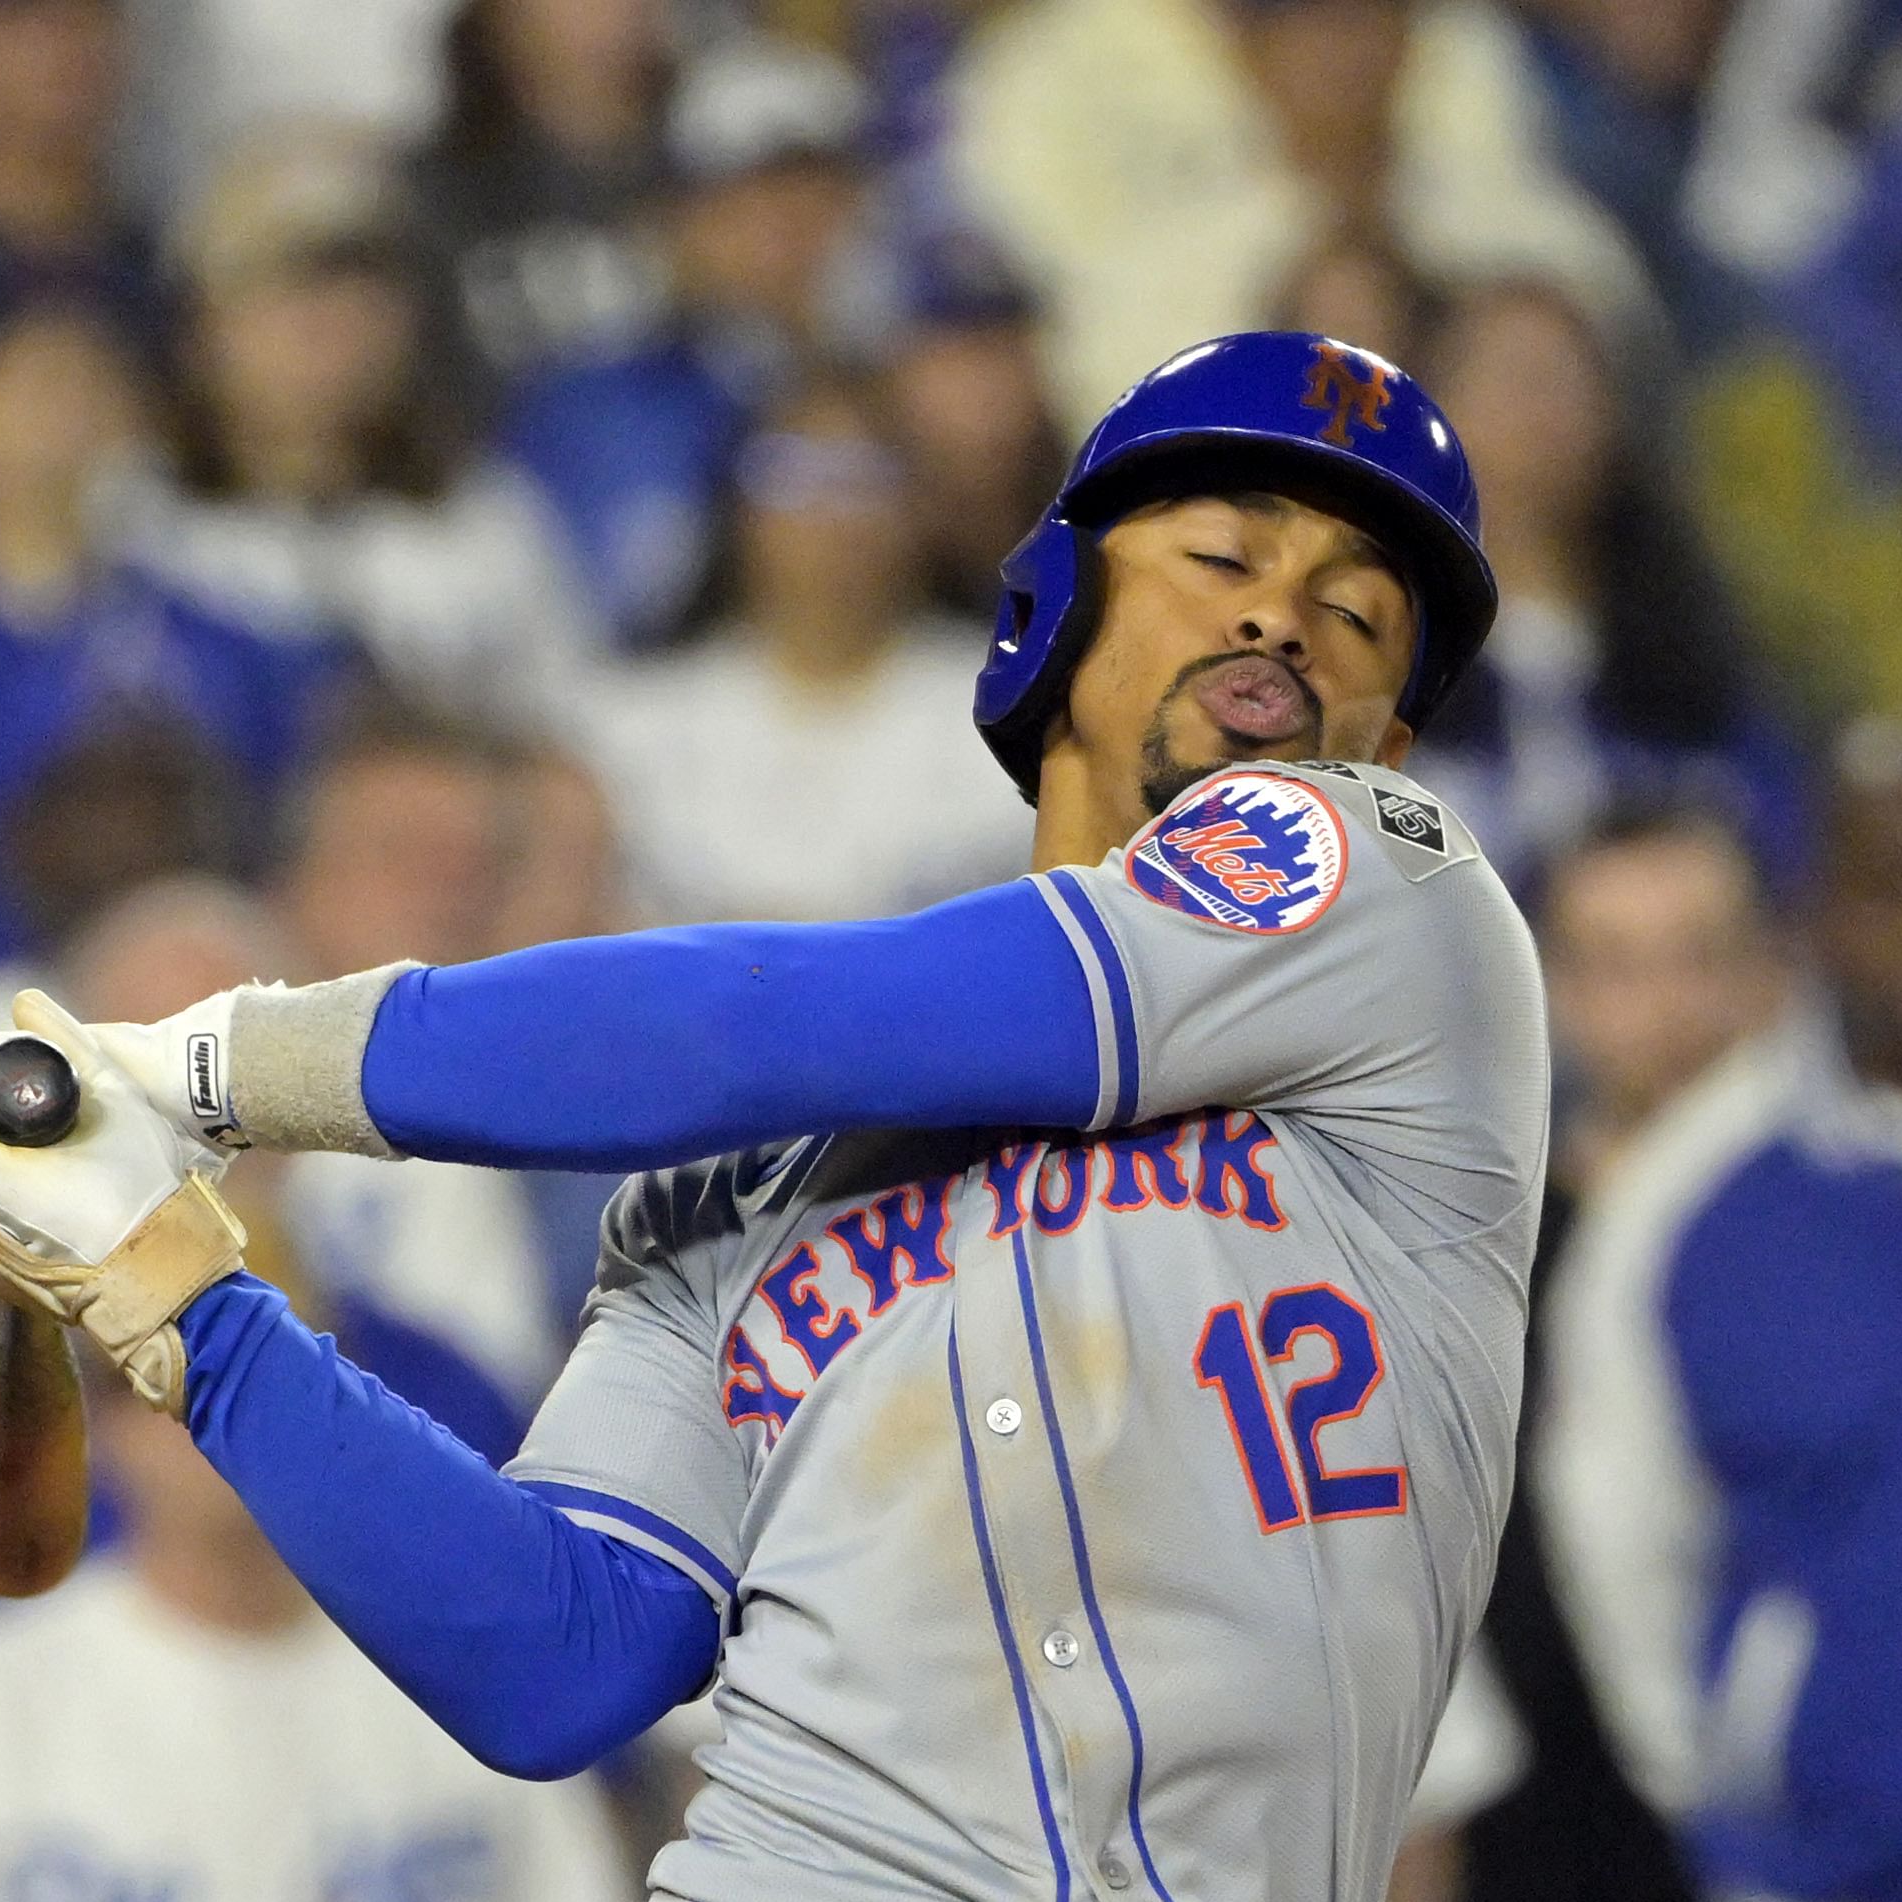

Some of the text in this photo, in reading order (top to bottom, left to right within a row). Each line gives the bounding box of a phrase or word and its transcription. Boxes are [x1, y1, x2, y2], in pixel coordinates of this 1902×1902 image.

[1163, 816, 1288, 904] Mets
[722, 1106, 1290, 1450] NEW YORK
[1193, 1281, 1408, 1536] 12
